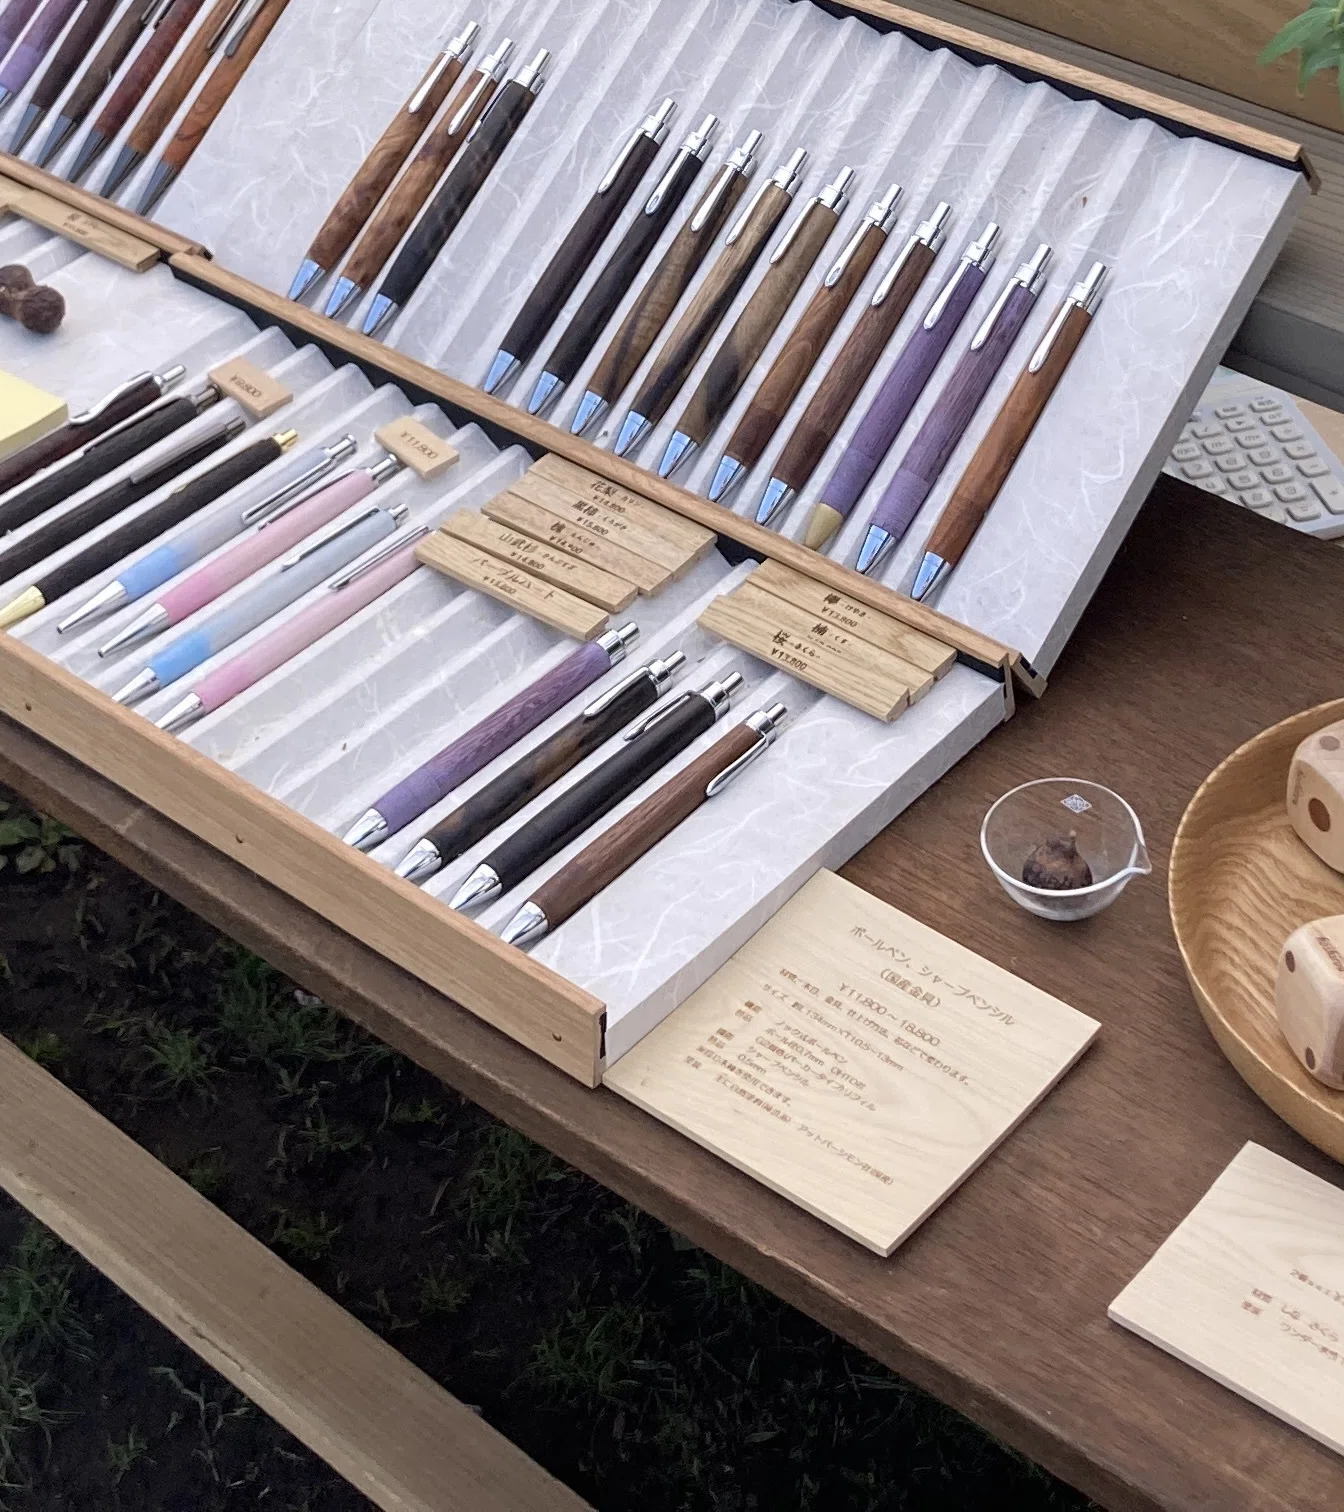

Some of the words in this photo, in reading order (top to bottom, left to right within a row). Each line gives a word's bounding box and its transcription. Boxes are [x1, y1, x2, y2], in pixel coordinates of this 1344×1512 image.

[588, 479, 619, 497] 花梨
[471, 553, 558, 602] パープルハート
[847, 924, 1019, 1027] ボールペン、シャープペンシル
